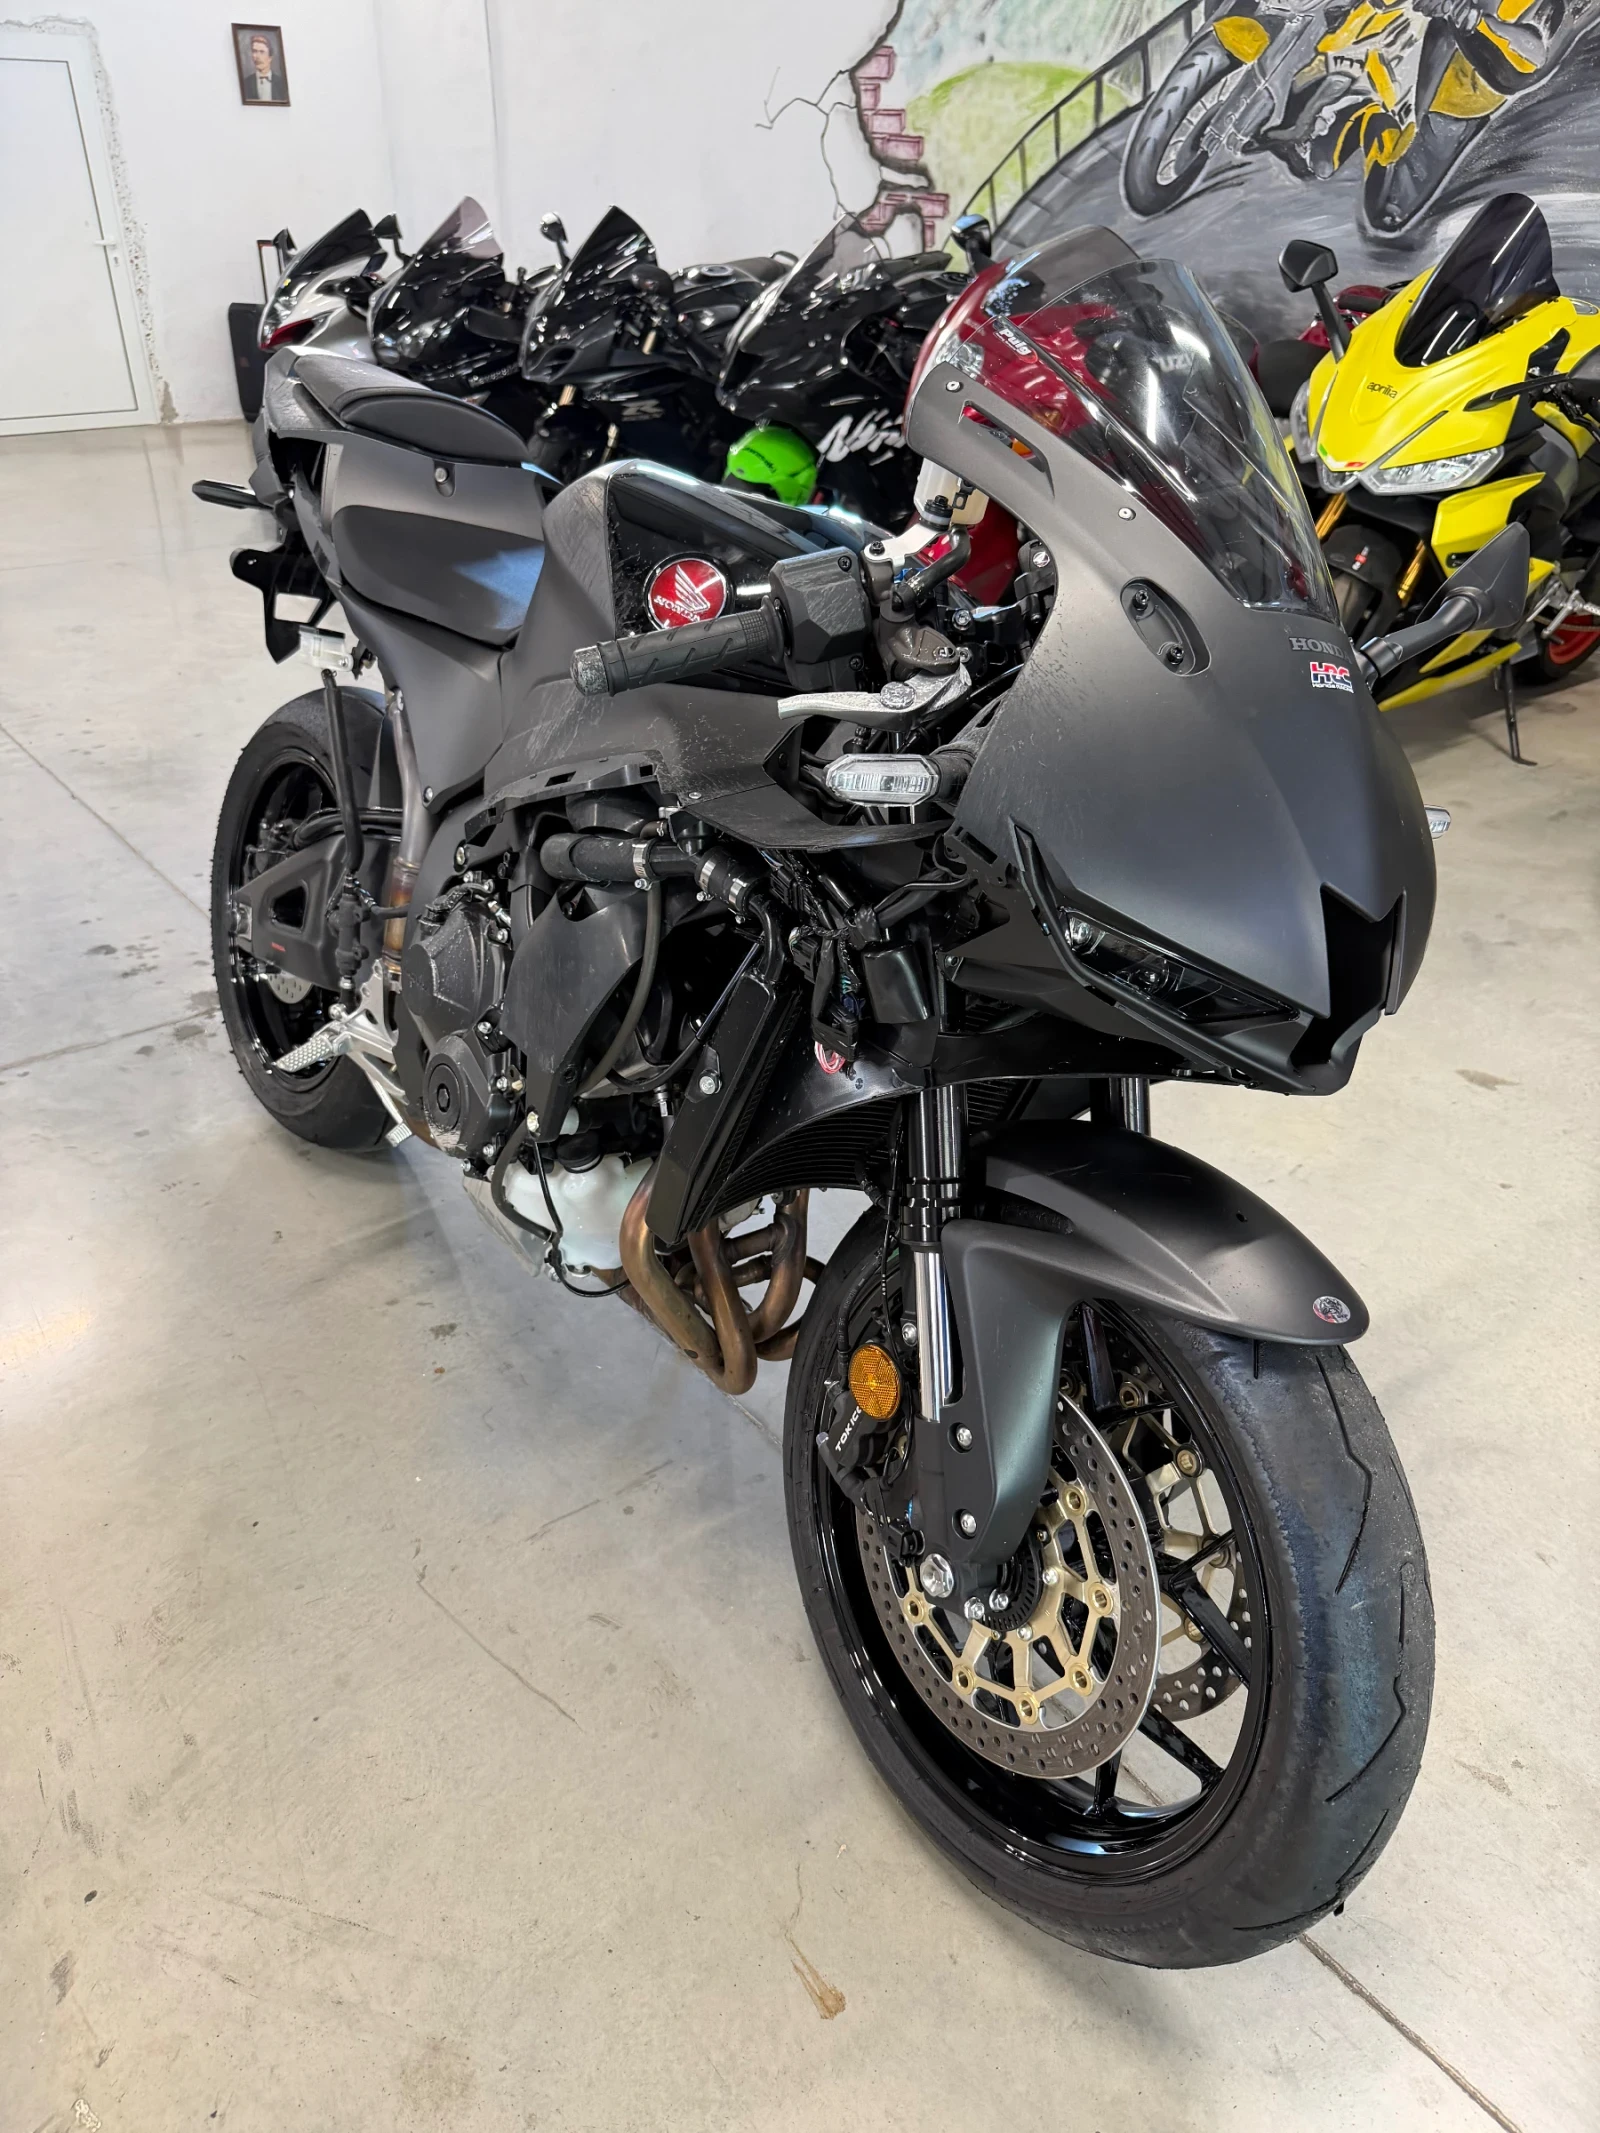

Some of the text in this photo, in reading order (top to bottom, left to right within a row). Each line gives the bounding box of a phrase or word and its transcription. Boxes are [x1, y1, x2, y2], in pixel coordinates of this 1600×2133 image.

[999, 328, 1032, 355] Puig
[1366, 381, 1398, 399] aprilia
[654, 595, 701, 622] HONDA
[1289, 637, 1353, 664] HONDA
[1310, 661, 1352, 688] HRC
